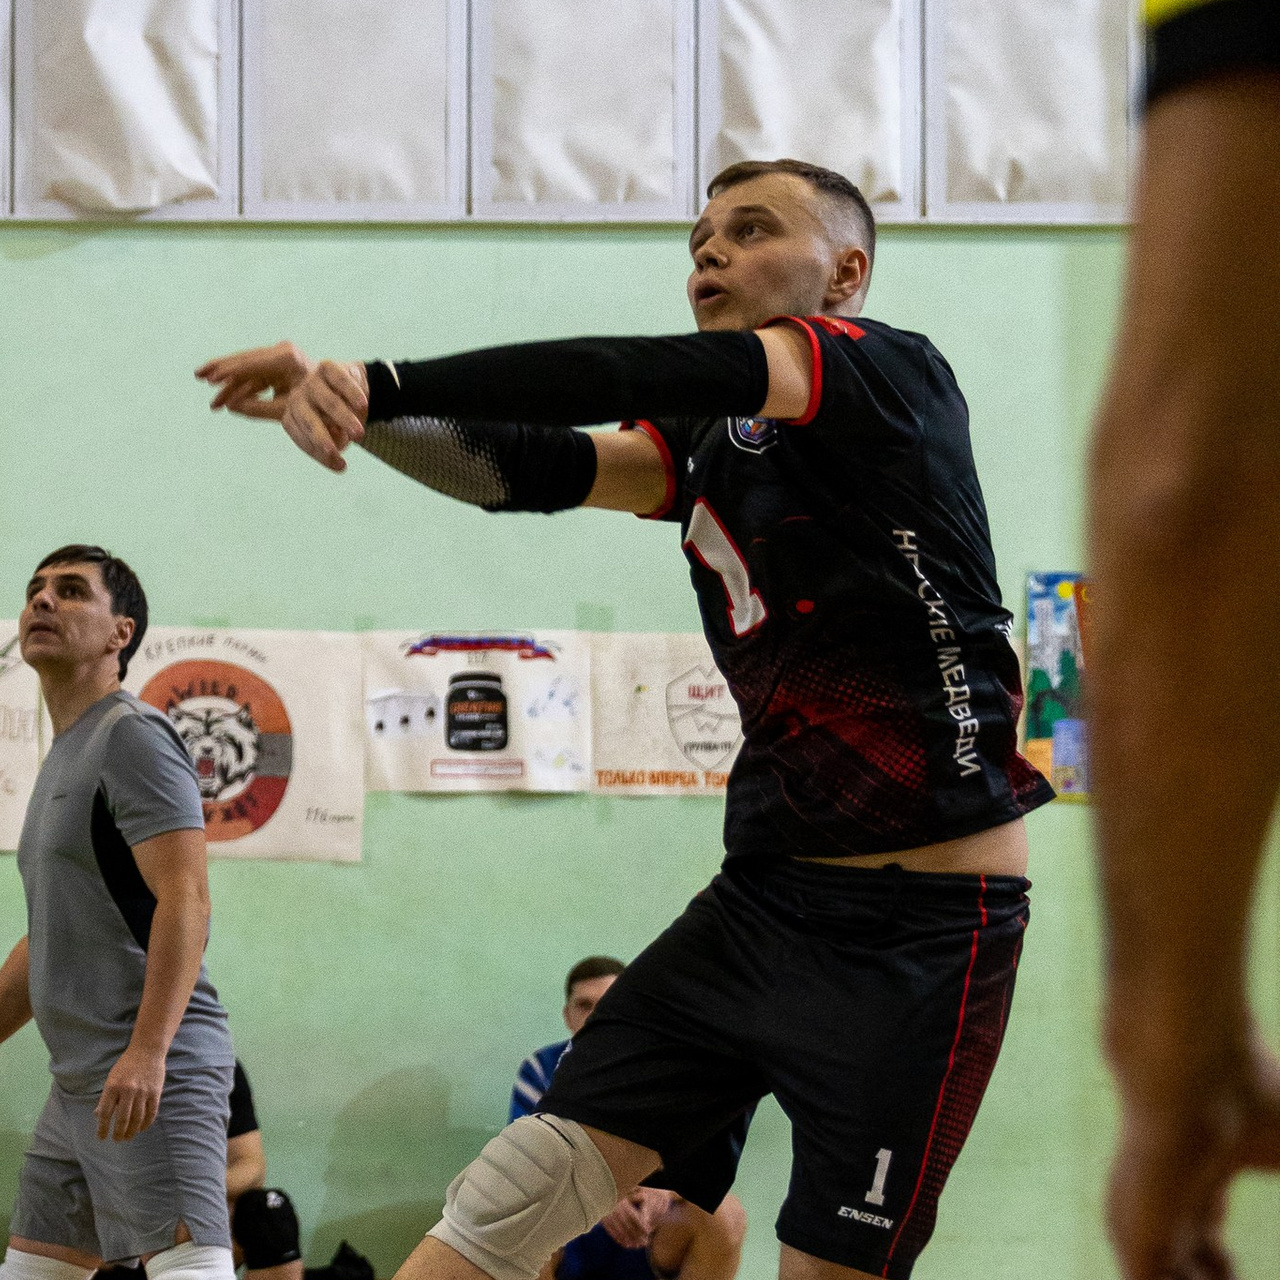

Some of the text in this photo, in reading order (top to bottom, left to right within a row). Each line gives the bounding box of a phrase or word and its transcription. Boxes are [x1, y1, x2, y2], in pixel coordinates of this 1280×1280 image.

[172, 679, 239, 700] WILD
[687, 684, 725, 700] ЩИТ
[937, 646, 980, 778] МЕДВЕДИ
[595, 770, 646, 787] ТОЛЬКО
[864, 1147, 893, 1207] 1
[836, 1206, 894, 1230] ENSEN
